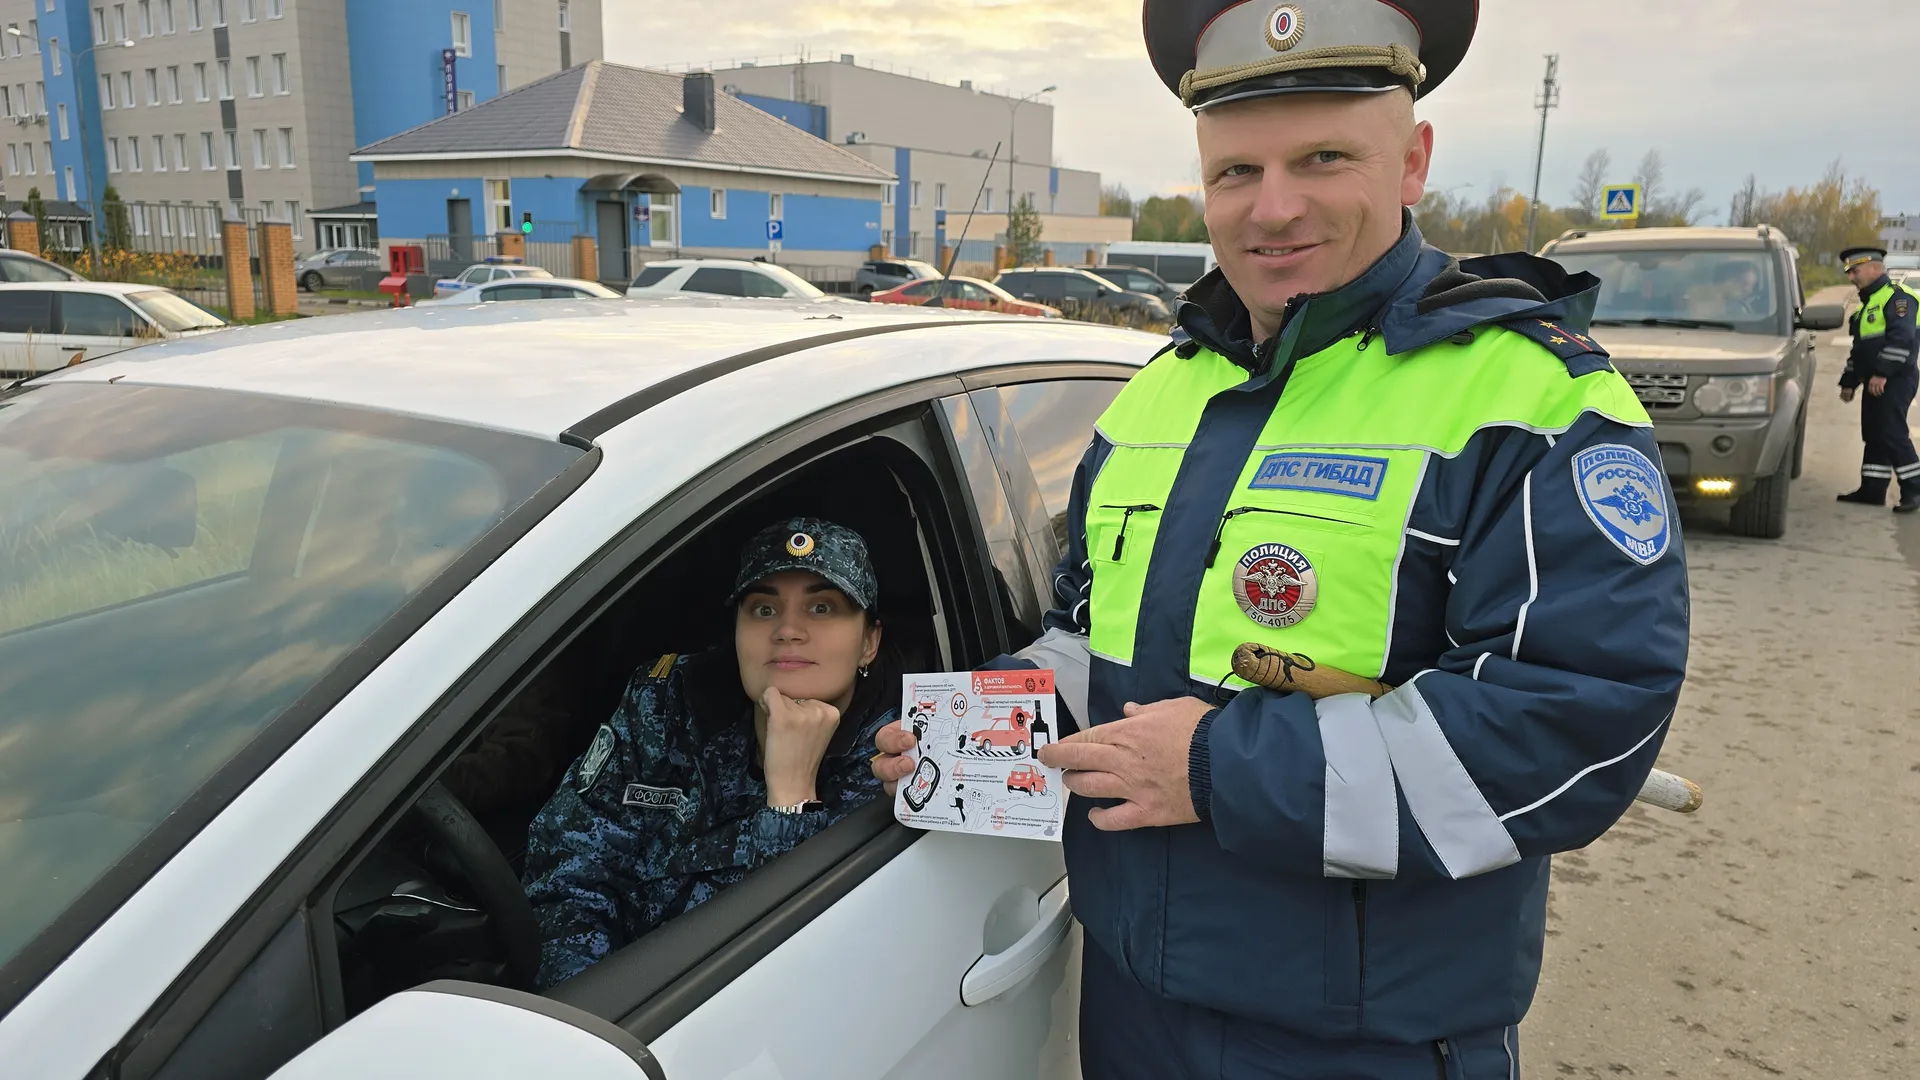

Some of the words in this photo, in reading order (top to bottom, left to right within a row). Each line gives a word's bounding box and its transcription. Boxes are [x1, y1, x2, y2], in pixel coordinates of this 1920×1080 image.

[768, 221, 780, 238] P
[1261, 460, 1302, 480] ДПС
[1303, 461, 1374, 488] ГИБДД
[1583, 450, 1657, 483] ПОЛИЦИЯ
[1624, 535, 1657, 557] МВД
[1241, 544, 1308, 571] ПОЛИЦИЯ
[1258, 597, 1287, 612] ДПС
[1250, 611, 1295, 627] 50-4075
[953, 700, 965, 711] 60
[634, 789, 668, 804] ФССП
